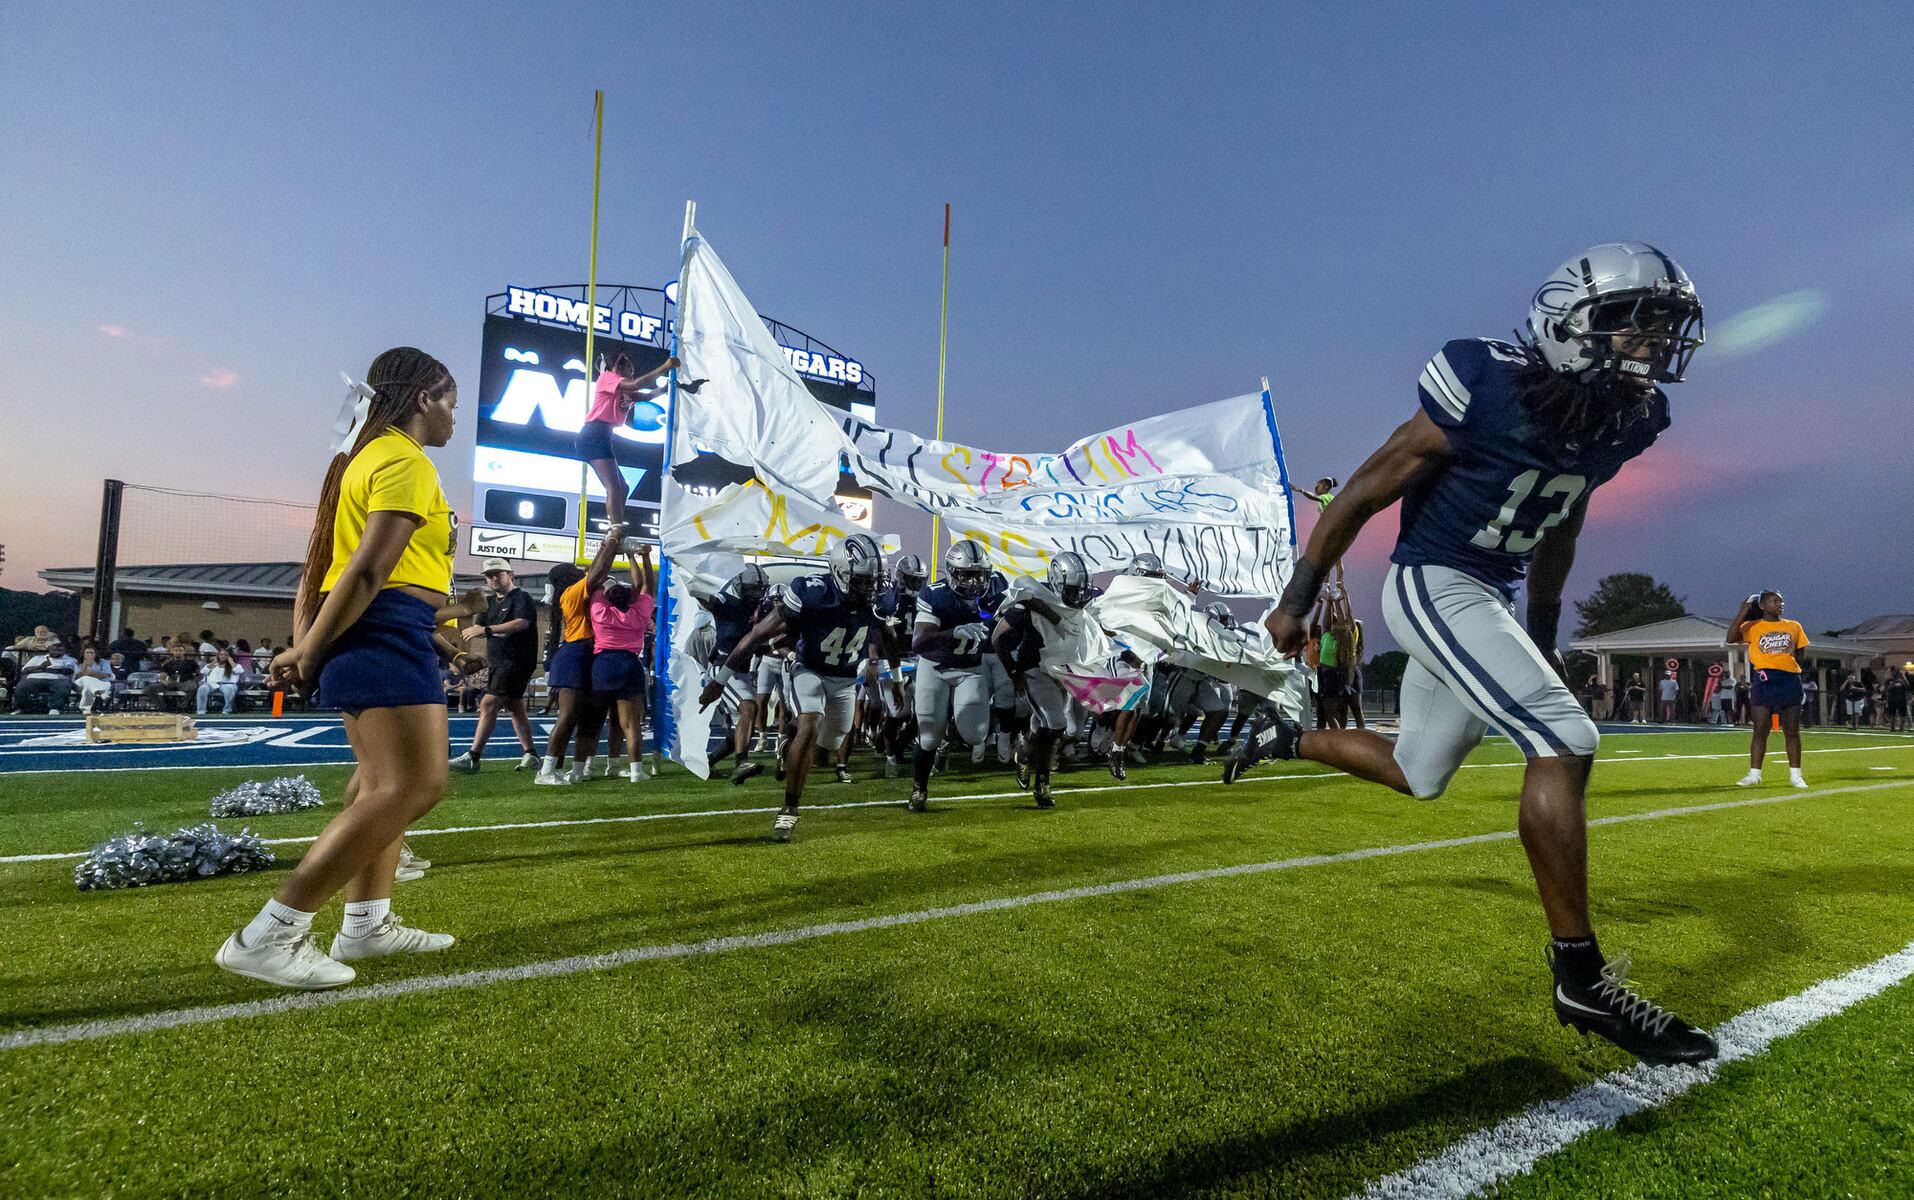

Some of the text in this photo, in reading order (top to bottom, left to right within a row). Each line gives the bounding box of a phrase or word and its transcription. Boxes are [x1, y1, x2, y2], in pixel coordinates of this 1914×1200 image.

[506, 286, 663, 342] HOME OF
[1470, 469, 1586, 553] 13
[477, 545, 517, 555] JUST DO IT
[820, 626, 869, 666] 44
[1759, 634, 1791, 646] COUGAR
[1763, 640, 1791, 650] CHEER
